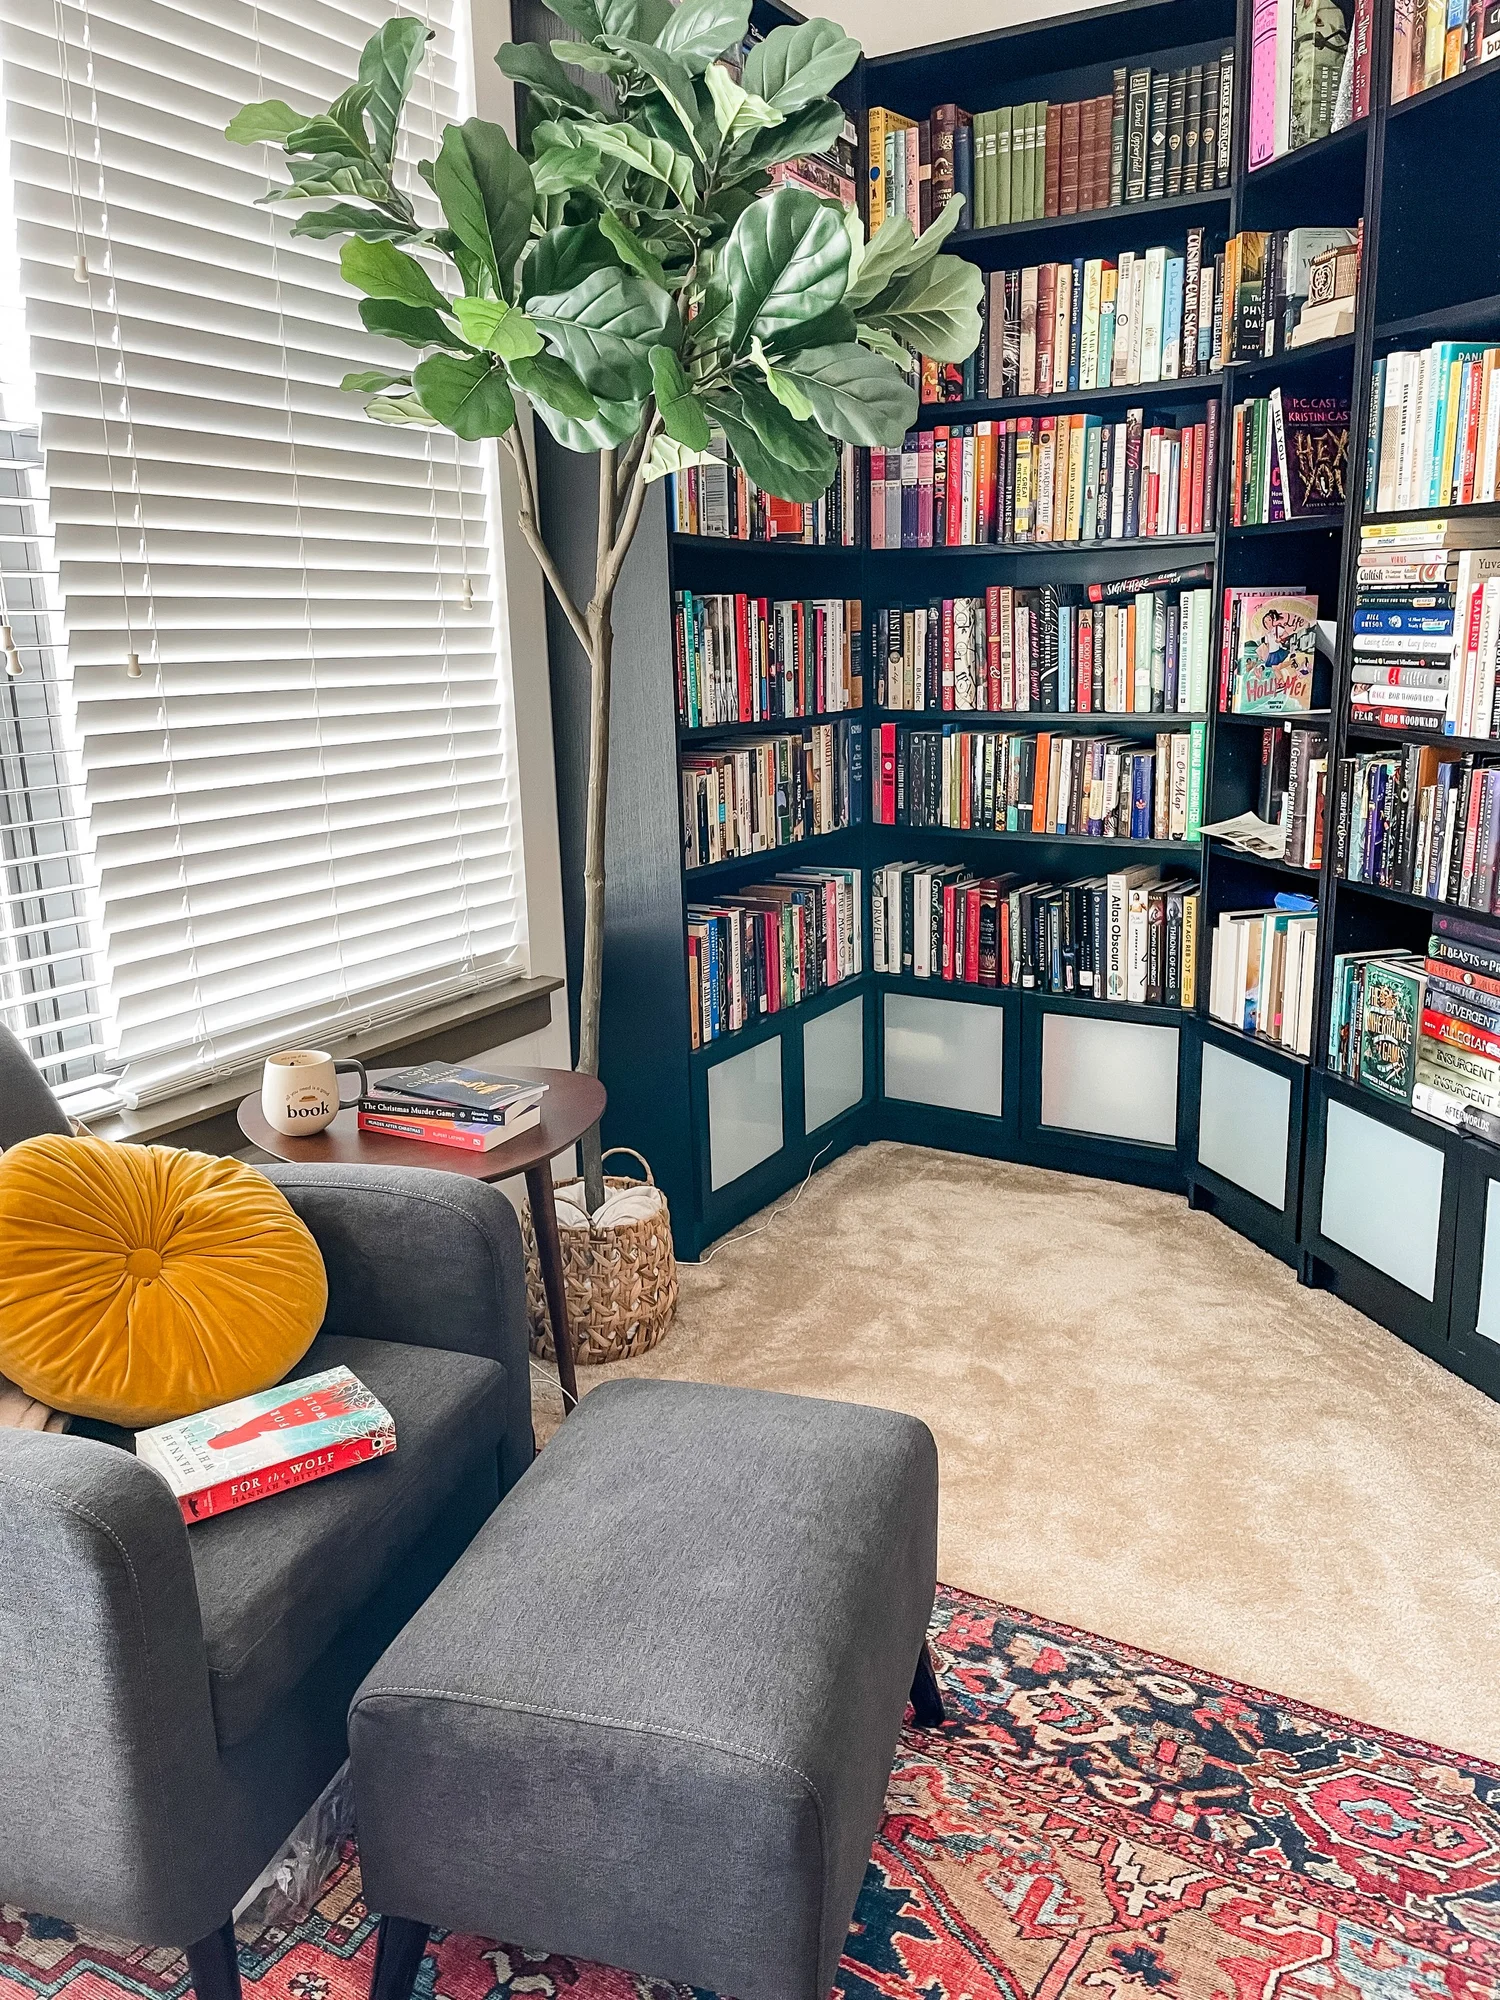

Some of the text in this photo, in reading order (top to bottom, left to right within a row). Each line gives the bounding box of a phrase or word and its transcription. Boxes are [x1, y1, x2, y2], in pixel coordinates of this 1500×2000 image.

[1221, 82, 1230, 139] HOUSE SEVEN
[1131, 99, 1144, 174] David Copperfield
[1185, 235, 1199, 313] COSMOS CARL
[1214, 294, 1222, 313] THE
[1293, 398, 1336, 408] P.C. CAST
[1416, 360, 1426, 424] MINDWANDERING
[1288, 411, 1352, 422] KRISTIN CAS
[1126, 439, 1141, 470] 1776
[934, 441, 947, 499] BLACK BUCK
[1042, 463, 1050, 498] STARDUST
[1106, 580, 1126, 595] SIGN
[1360, 569, 1383, 581] Cultish
[1002, 592, 1010, 604] THE
[1002, 604, 1010, 613] DA
[1155, 597, 1163, 620] ALICE
[890, 609, 900, 650] EINSTEIN
[1002, 615, 1010, 631] VINCI
[1283, 613, 1304, 631] Life
[1471, 599, 1481, 648] SAPIENS
[943, 637, 951, 658] gods
[1364, 637, 1437, 650] Losing Eden Lucy Jones
[1031, 670, 1039, 700] BUNNY
[1372, 691, 1433, 702] RAGE BOB WOODWARD
[1354, 711, 1438, 728] FEAR BOB WOODWARD
[1172, 761, 1185, 809] On Map
[1285, 748, 1301, 837] Great SUPERNATURAL
[1478, 786, 1486, 824] CLOCKWORK
[1482, 830, 1490, 864] WITCHES
[874, 900, 882, 943] ORWELL
[1111, 895, 1121, 971] Atlas Obscura
[702, 936, 710, 984] SILMARILLION
[1169, 956, 1176, 966] OF
[1446, 942, 1480, 967] BEASTS
[1366, 1012, 1412, 1045] INHERITANCE
[1446, 1003, 1498, 1028] DIVERGENT
[1436, 1049, 1495, 1082] INSURGENT
[1433, 1074, 1494, 1108] INSURGENT
[287, 1101, 329, 1118] book
[362, 1102, 456, 1118] The Christmas Murder Game
[1445, 1106, 1490, 1132] AFTERWORLDS
[398, 1124, 422, 1134] CHRISTMAS
[448, 1134, 465, 1142] LATIMER
[269, 1410, 290, 1428] FOR
[302, 1396, 328, 1420] WOLF
[161, 1434, 196, 1476] HANNAH
[179, 1426, 215, 1472] WHITTEN
[230, 1451, 335, 1497] FOR the WOLF
[232, 1482, 282, 1506] HANNAH
[283, 1462, 336, 1486] WHITTEN
